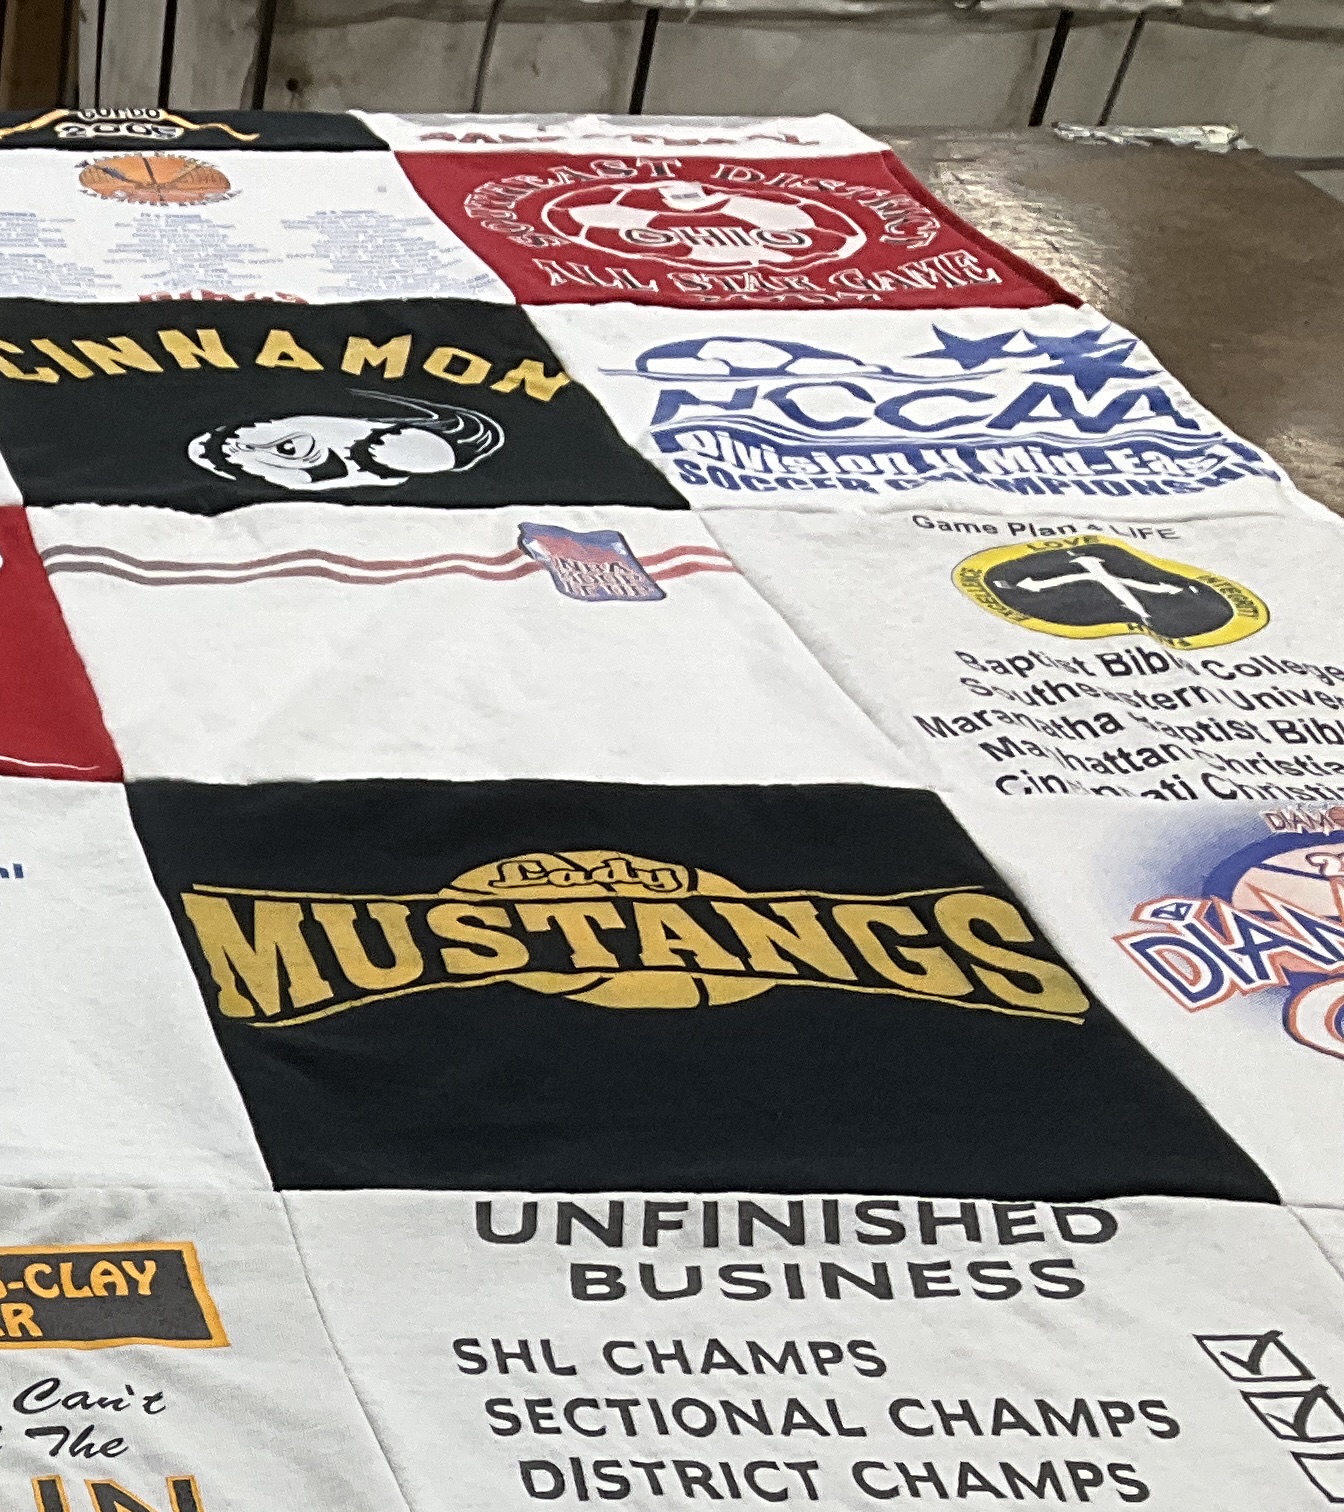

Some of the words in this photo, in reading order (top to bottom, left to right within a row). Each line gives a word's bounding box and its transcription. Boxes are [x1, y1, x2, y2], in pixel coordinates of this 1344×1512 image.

[620, 226, 813, 249] OHIO
[532, 257, 659, 293] ALL
[828, 248, 1003, 292] GAME
[649, 381, 1201, 434] NCCAA
[911, 513, 998, 535] Game
[1006, 521, 1077, 537] Plan
[1111, 523, 1180, 540] LIFE
[1026, 535, 1100, 551] LOVE
[954, 649, 1097, 676] Baptist
[1200, 654, 1344, 686] College
[490, 853, 692, 894] Lady
[184, 892, 1092, 1024] MUSTANGS
[474, 1198, 1119, 1249] UNFINISHED
[569, 1258, 1087, 1302] BUSINESS
[450, 1337, 577, 1378] SHL
[602, 1337, 888, 1379] CHAMPS
[11, 1378, 168, 1418] Can't
[484, 1396, 866, 1440] SECTIONAL
[888, 1398, 1181, 1441] CHAMPS
[26, 1424, 130, 1460] The
[518, 1457, 822, 1502] DISTRICT
[850, 1458, 1152, 1504] CHAMPS
